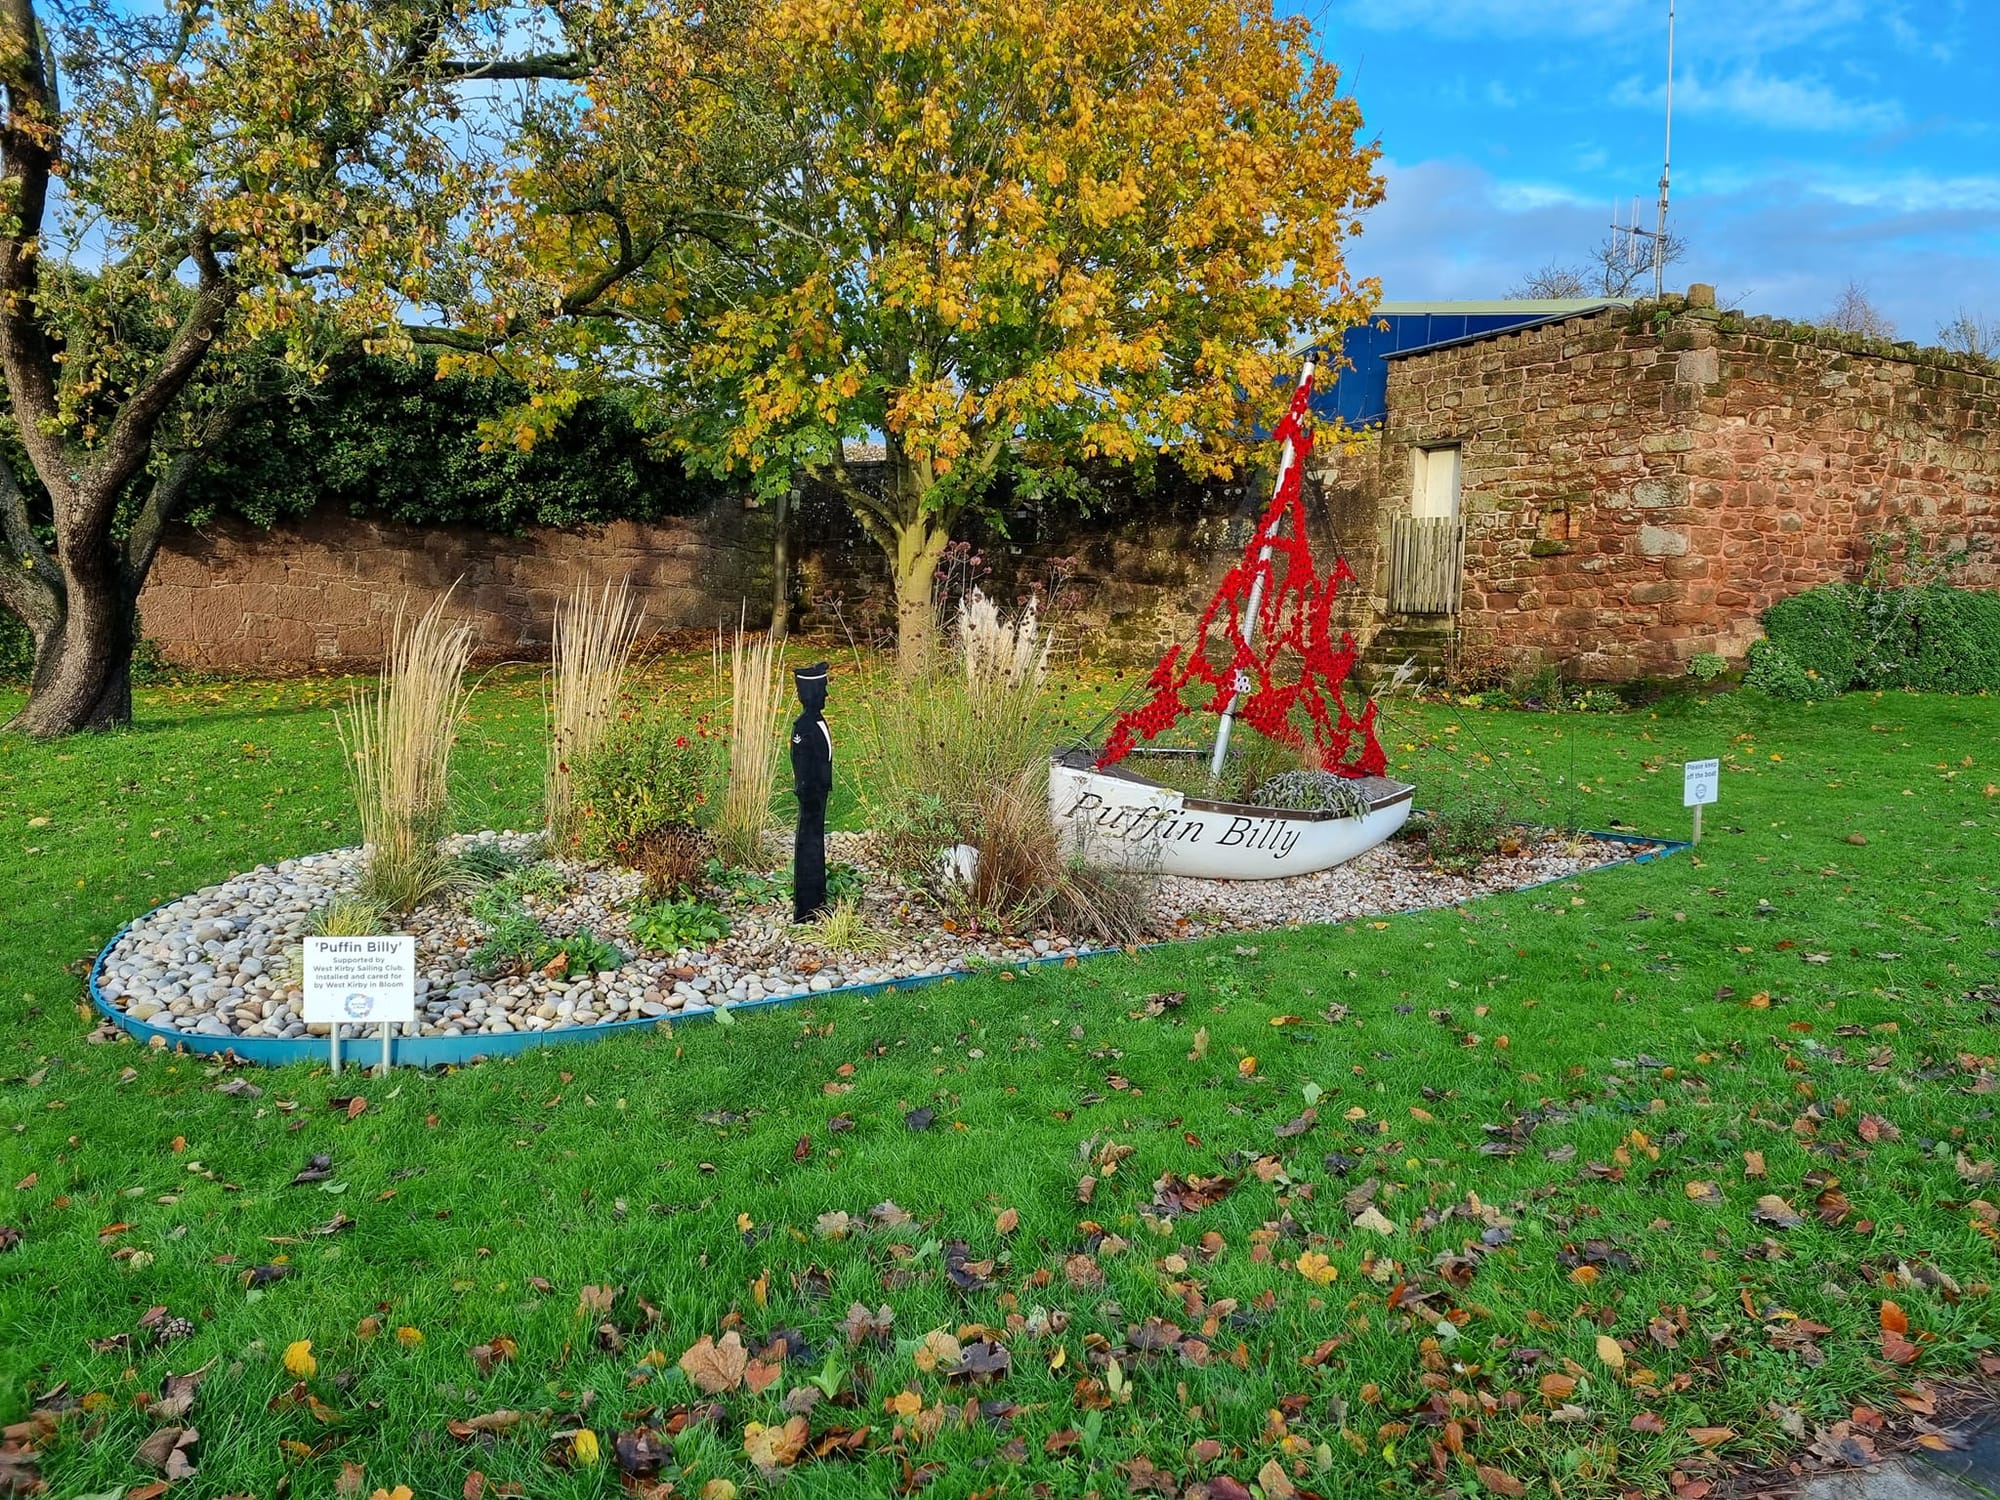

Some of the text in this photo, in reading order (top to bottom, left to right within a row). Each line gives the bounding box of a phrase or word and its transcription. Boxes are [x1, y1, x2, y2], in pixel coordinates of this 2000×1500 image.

[1062, 792, 1301, 859] Puffin Billy
[385, 964, 405, 972] Club.
[314, 981, 323, 989] by
[347, 981, 368, 989] Kirby
